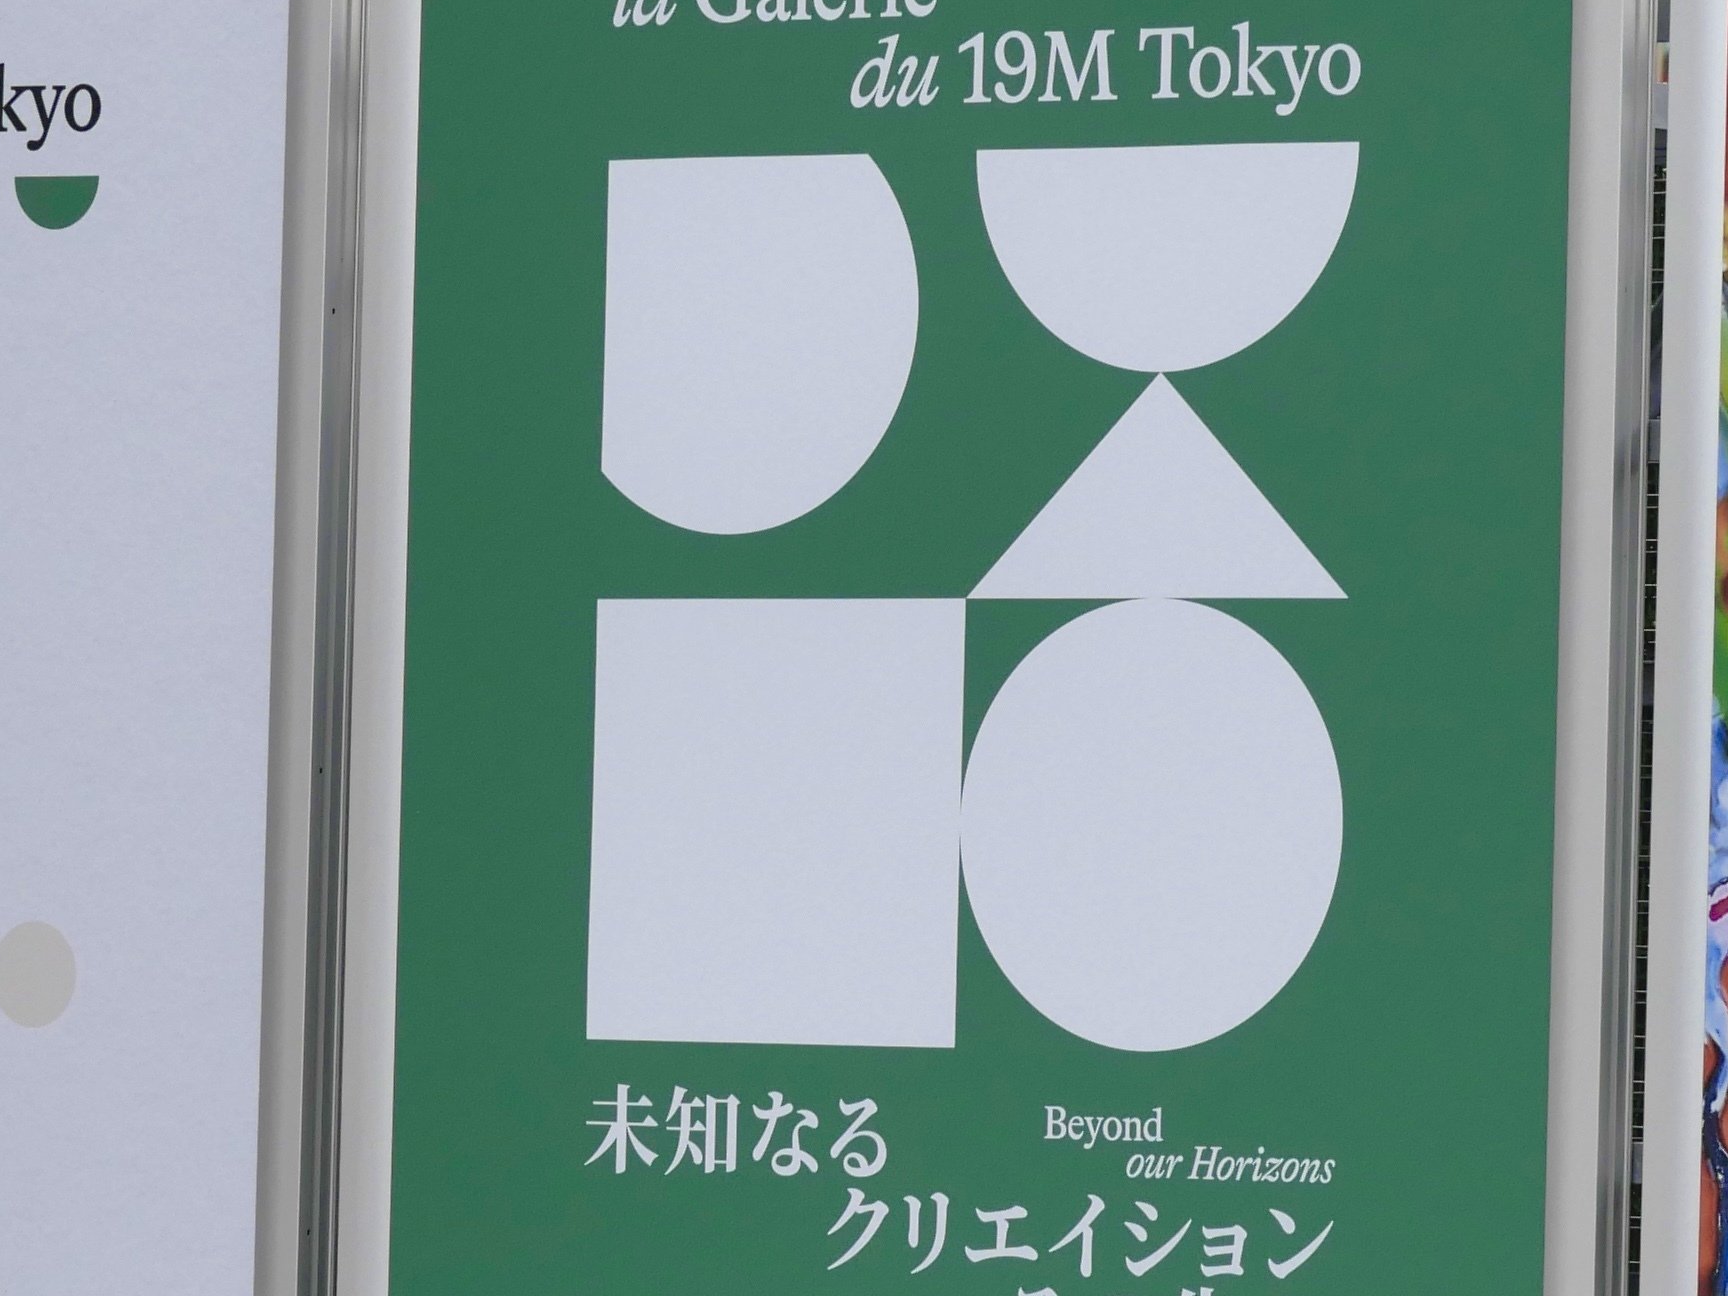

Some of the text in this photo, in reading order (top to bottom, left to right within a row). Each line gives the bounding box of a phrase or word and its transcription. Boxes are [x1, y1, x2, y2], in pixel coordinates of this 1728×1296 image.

[850, 21, 1362, 117] du 19M Tokyo
[584, 1084, 888, 1178] 未知なる
[1044, 1105, 1164, 1150] Beyond
[1126, 1145, 1336, 1184] our Horizons
[827, 1187, 1334, 1279] クリエイション
